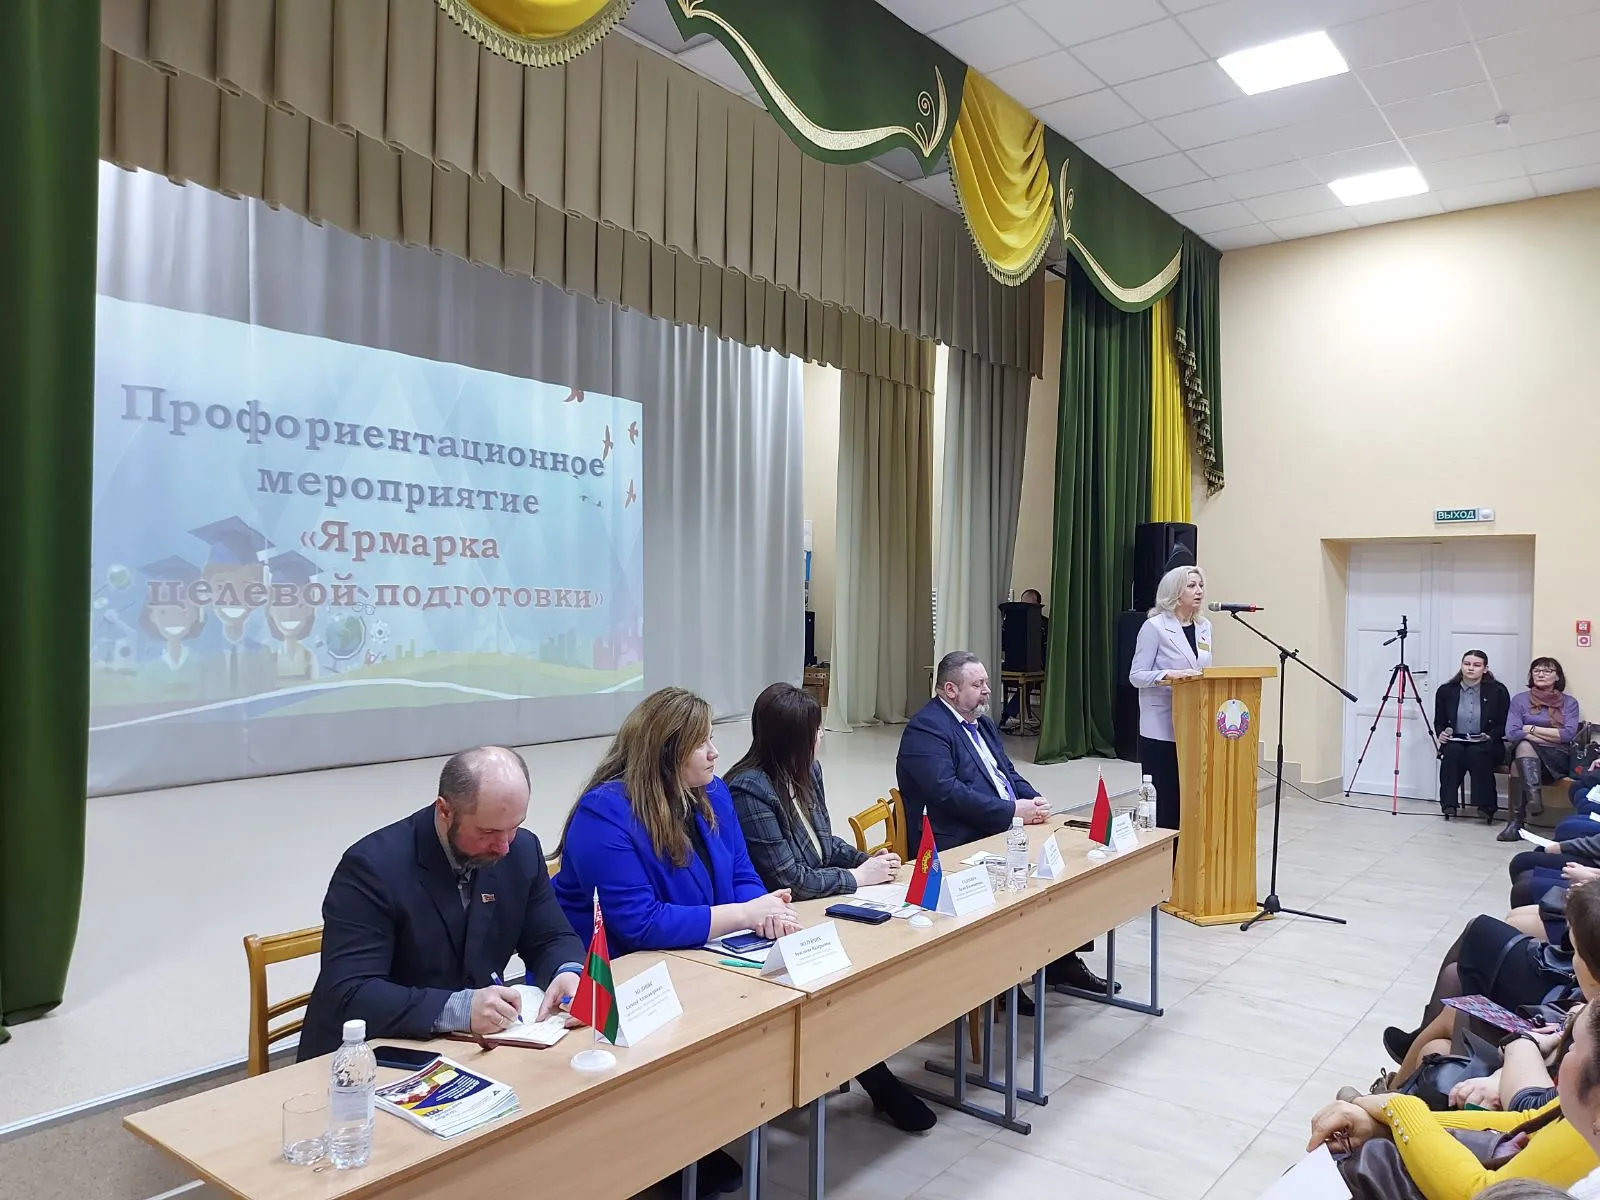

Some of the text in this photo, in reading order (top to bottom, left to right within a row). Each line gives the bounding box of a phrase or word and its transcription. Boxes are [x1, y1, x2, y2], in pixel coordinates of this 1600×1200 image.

[120, 383, 606, 477] Профориентационное
[256, 467, 540, 514] мероприятие
[1438, 510, 1475, 520] ВЫХОД
[300, 520, 500, 565] «Ярмарка
[147, 571, 604, 612] целевой подготовки»
